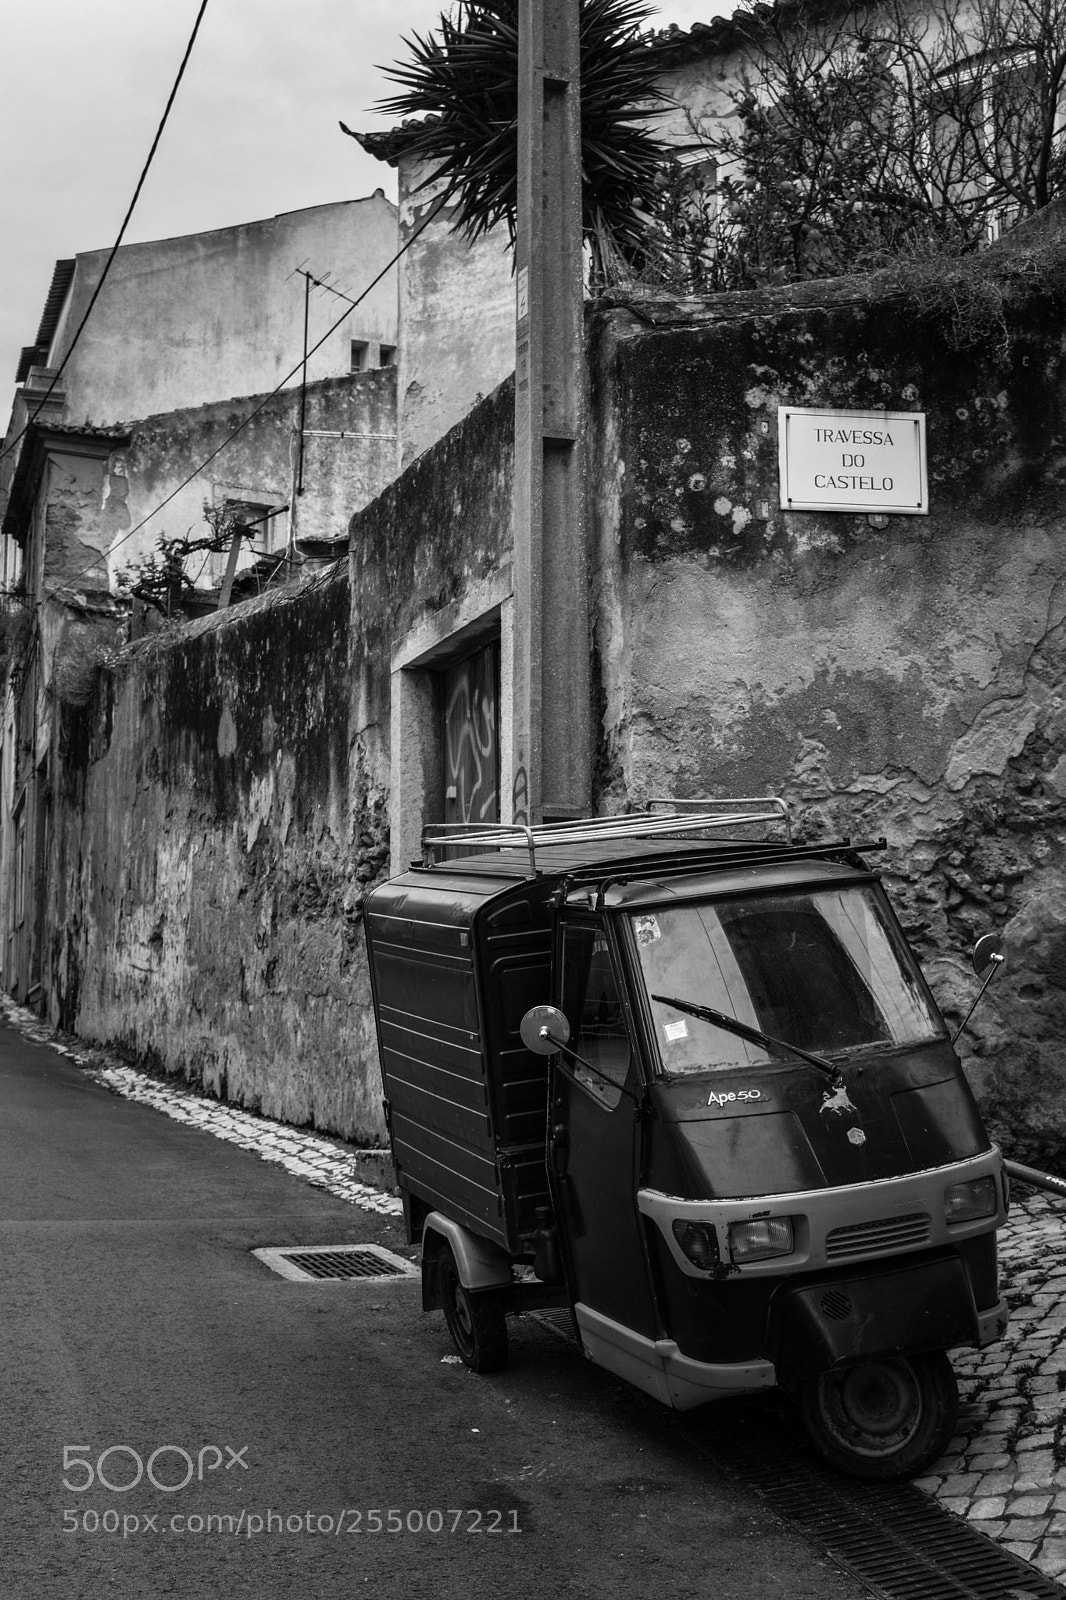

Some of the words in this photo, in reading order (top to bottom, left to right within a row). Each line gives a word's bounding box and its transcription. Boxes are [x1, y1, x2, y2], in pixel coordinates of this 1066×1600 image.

[814, 428, 894, 446] TRAVESSA
[842, 453, 865, 468] DO
[814, 474, 893, 491] CASTELO
